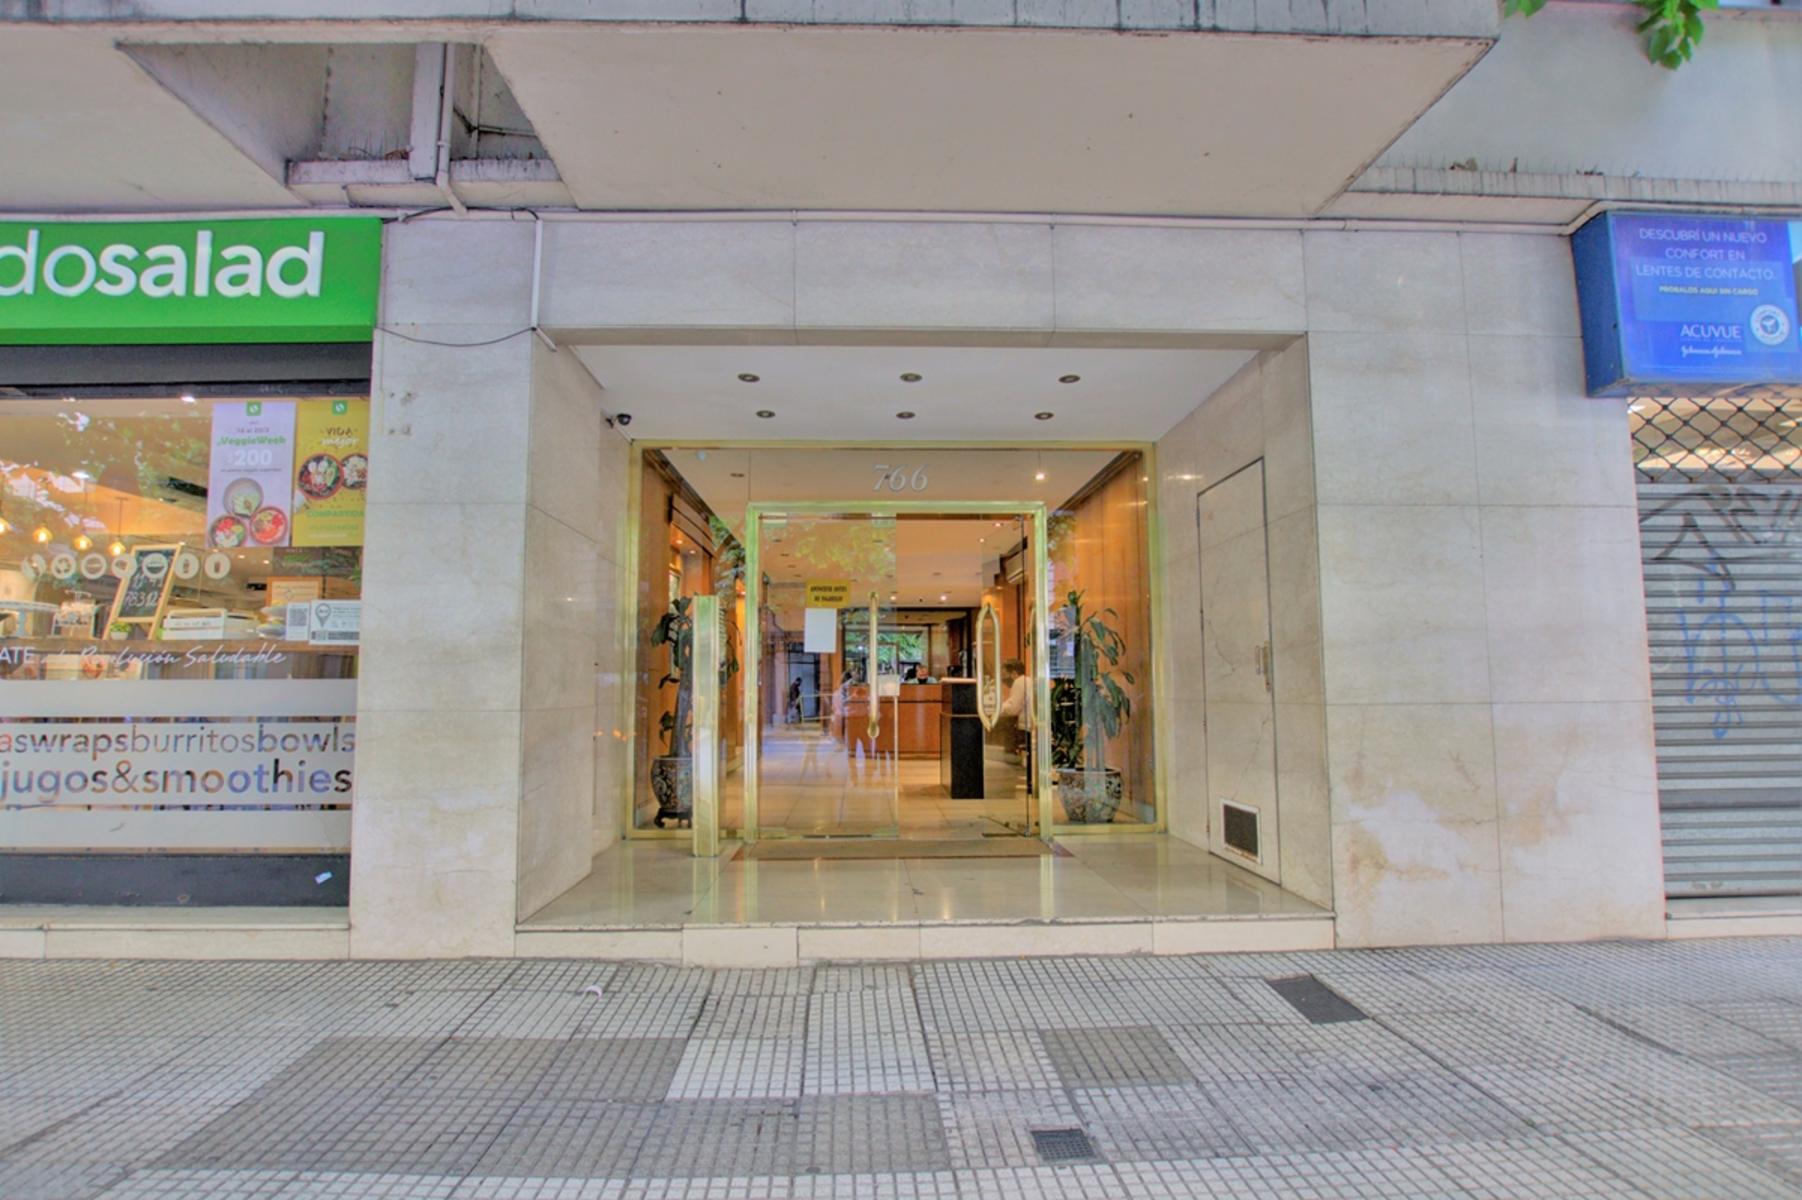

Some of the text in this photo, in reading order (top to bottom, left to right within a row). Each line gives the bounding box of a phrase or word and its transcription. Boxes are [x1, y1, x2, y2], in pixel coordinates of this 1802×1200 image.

[1702, 231, 1721, 243] UN
[1723, 232, 1768, 244] NUEVO
[1665, 248, 1746, 261] CONFORT EN
[1635, 264, 1683, 278] LENTES
[1685, 266, 1702, 279] DE
[1680, 324, 1742, 339] ACUVUE
[871, 463, 929, 493] 766
[183, 643, 287, 668] Saludable
